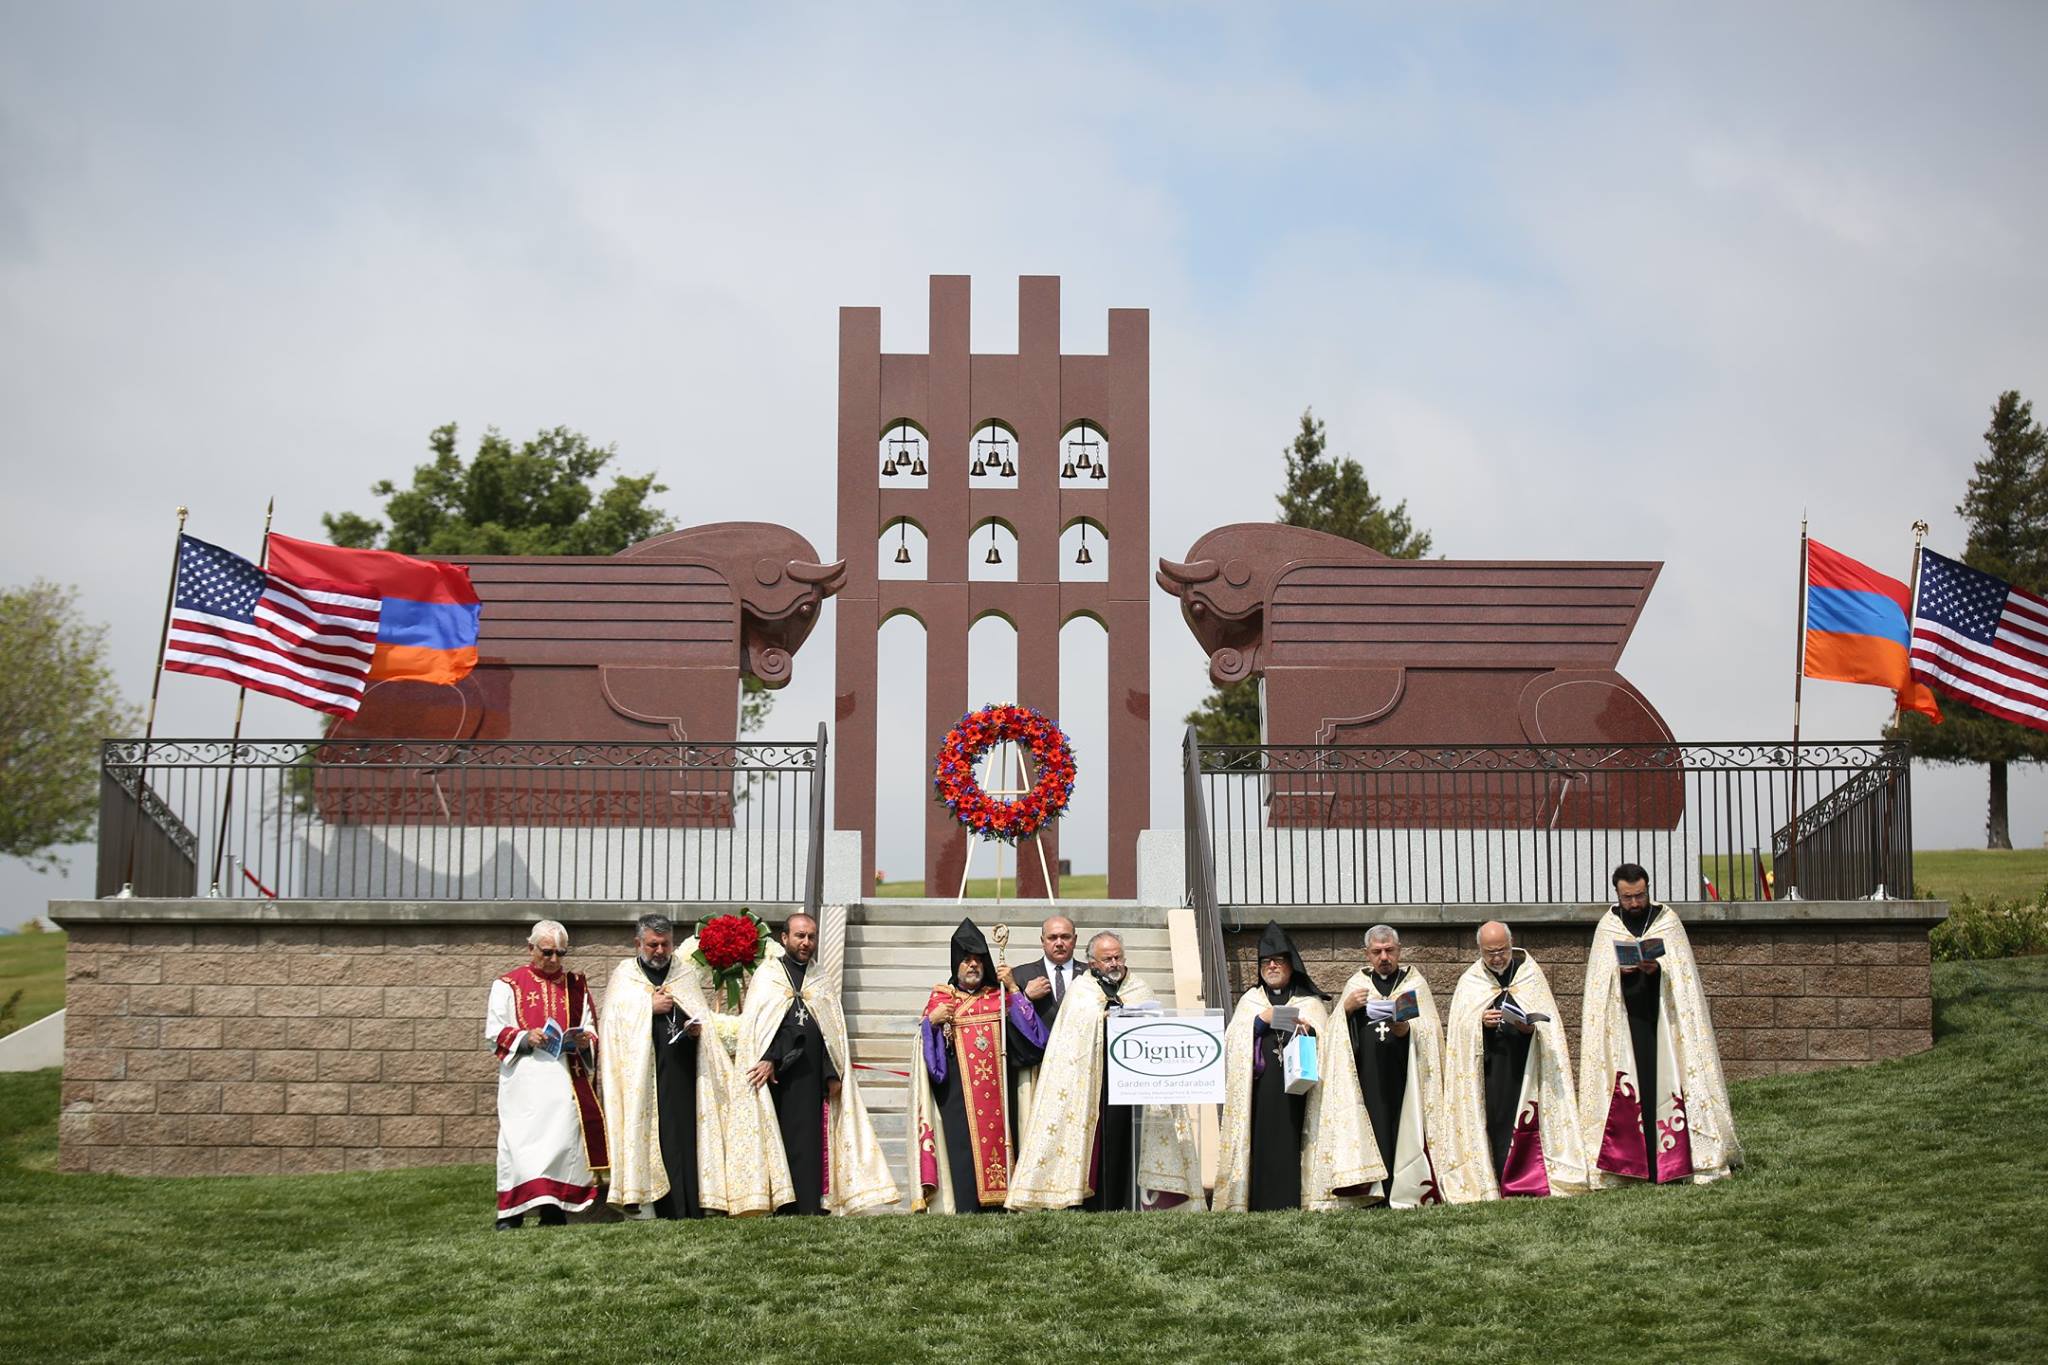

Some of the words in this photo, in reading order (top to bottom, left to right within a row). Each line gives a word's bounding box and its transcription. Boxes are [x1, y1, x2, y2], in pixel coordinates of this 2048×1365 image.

[1122, 1039, 1208, 1064] Dignity
[1117, 1080, 1150, 1088] Garden
[1152, 1080, 1162, 1088] of
